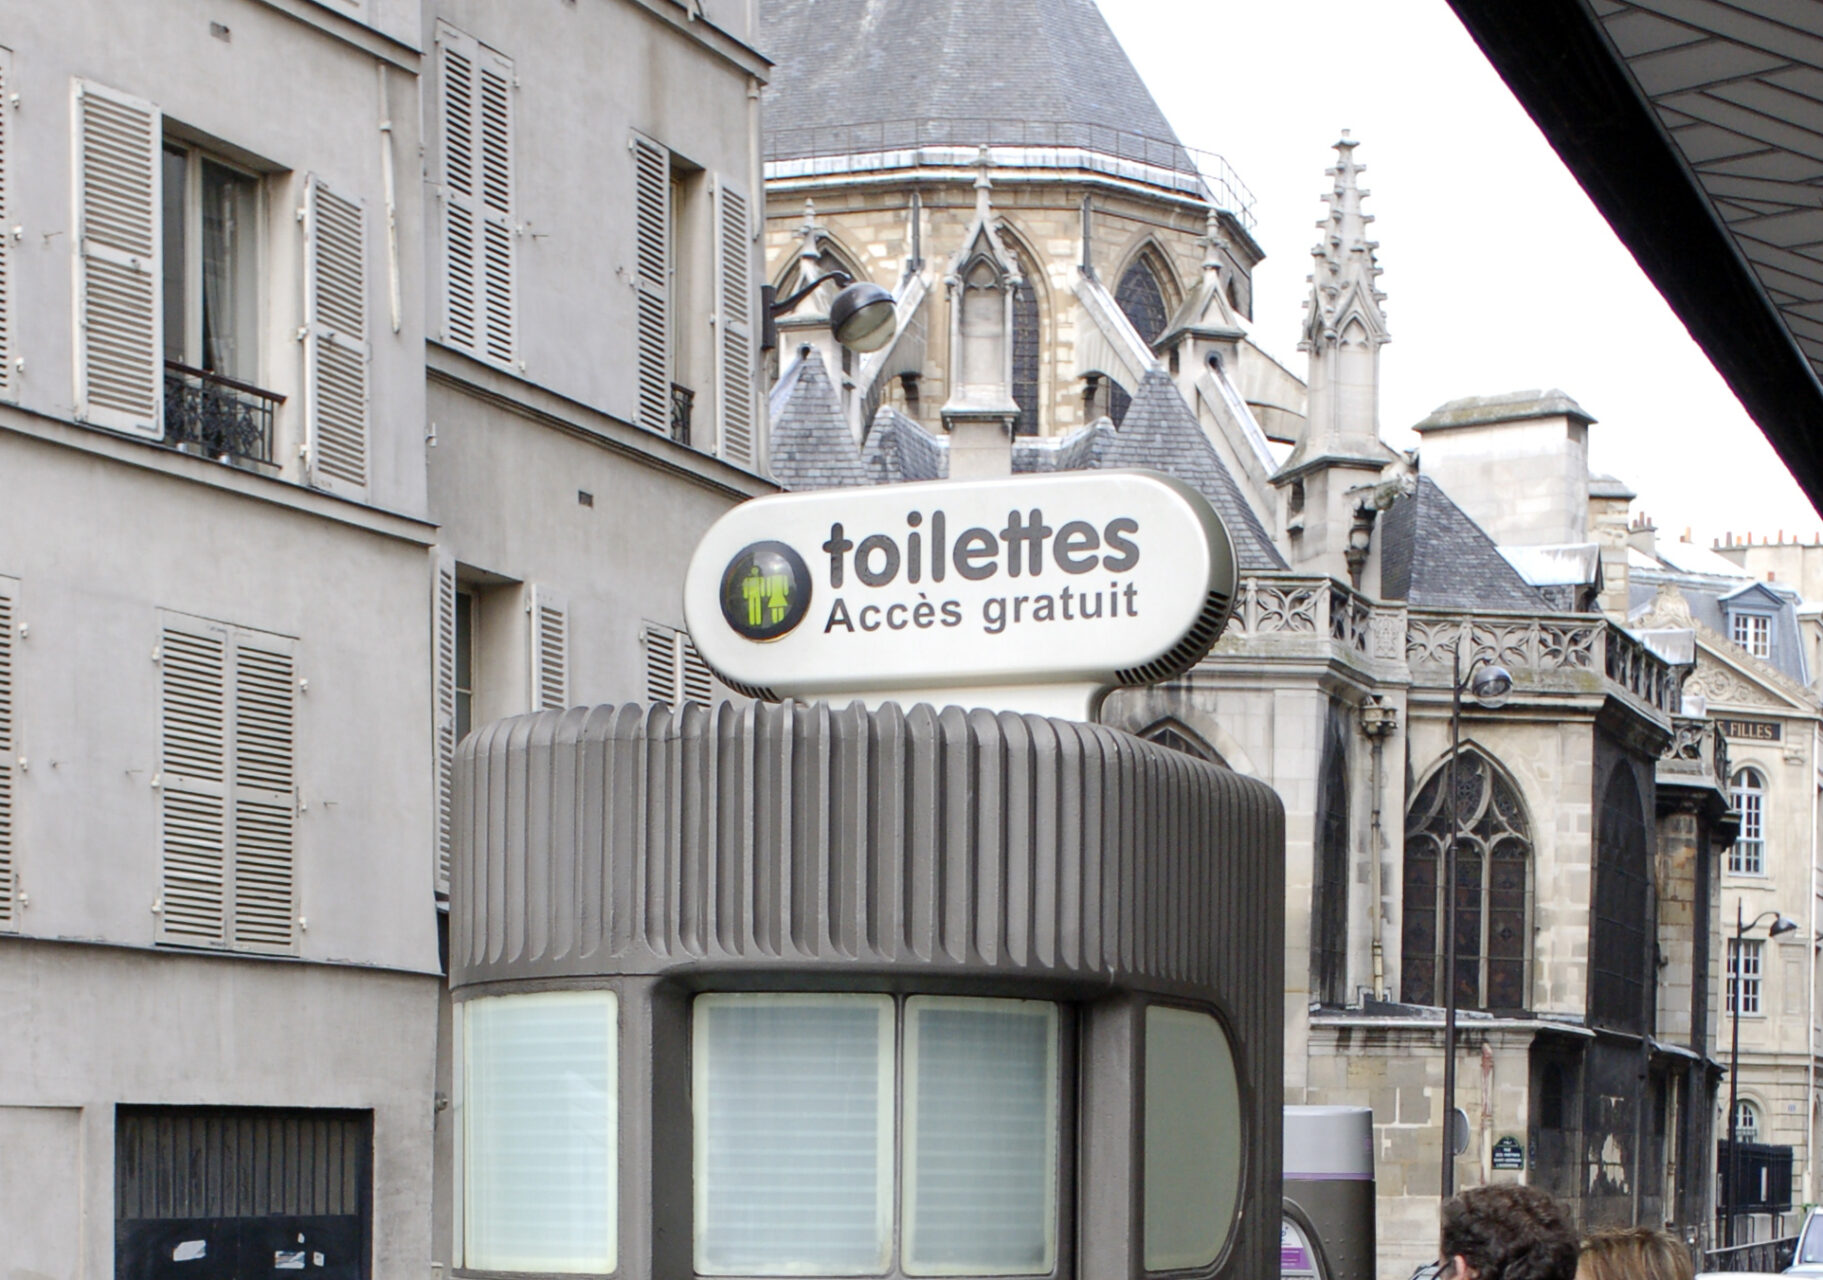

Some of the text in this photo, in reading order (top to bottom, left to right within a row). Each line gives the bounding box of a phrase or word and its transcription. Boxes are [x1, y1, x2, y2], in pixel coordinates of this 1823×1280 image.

[822, 508, 1141, 590] toilettes
[823, 581, 1139, 635] Accès gratuit
[1730, 721, 1773, 740] FILLES
